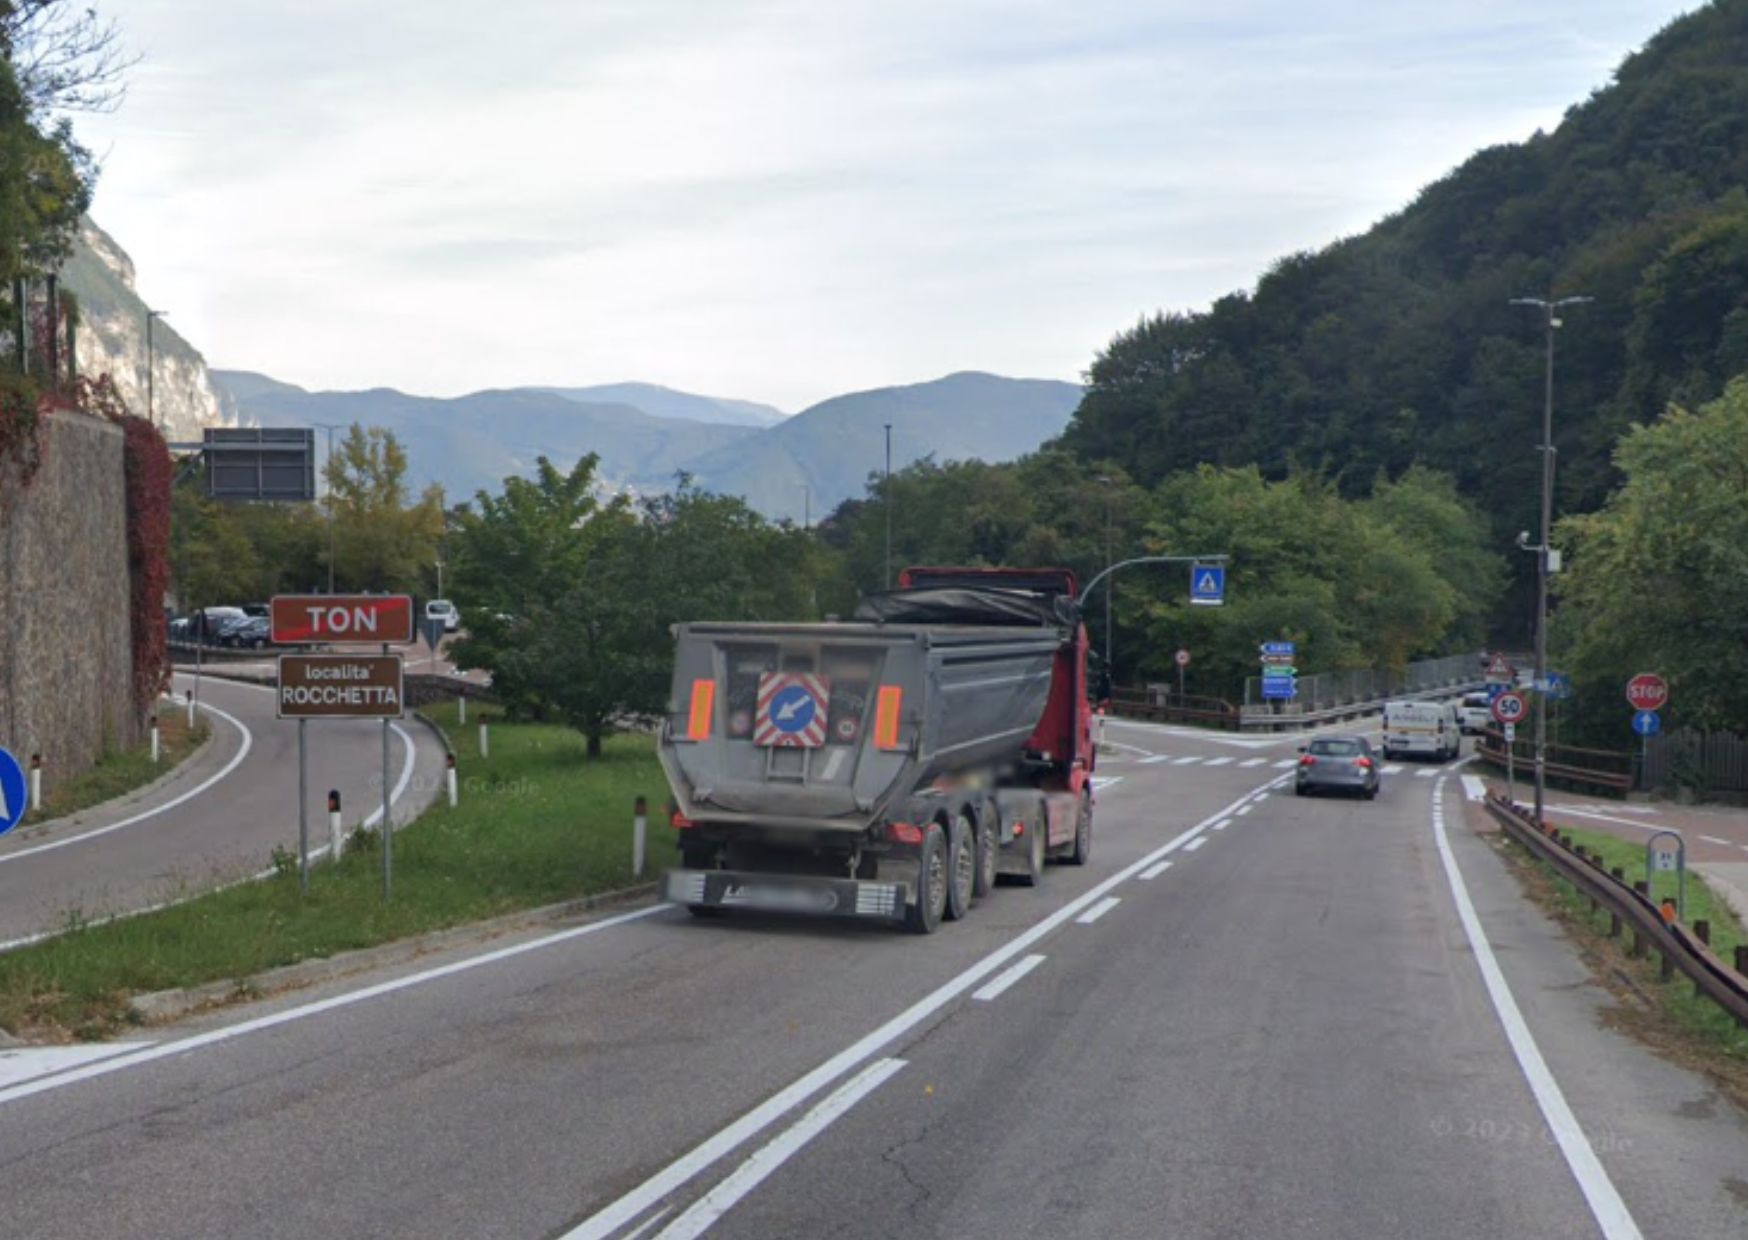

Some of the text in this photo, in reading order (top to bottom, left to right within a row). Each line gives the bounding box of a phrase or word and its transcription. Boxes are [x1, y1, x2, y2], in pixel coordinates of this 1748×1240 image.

[306, 607, 377, 632] TON
[282, 686, 399, 704] ROCCHETTA
[1632, 685, 1664, 698] STOP
[1501, 700, 1520, 714] 50
